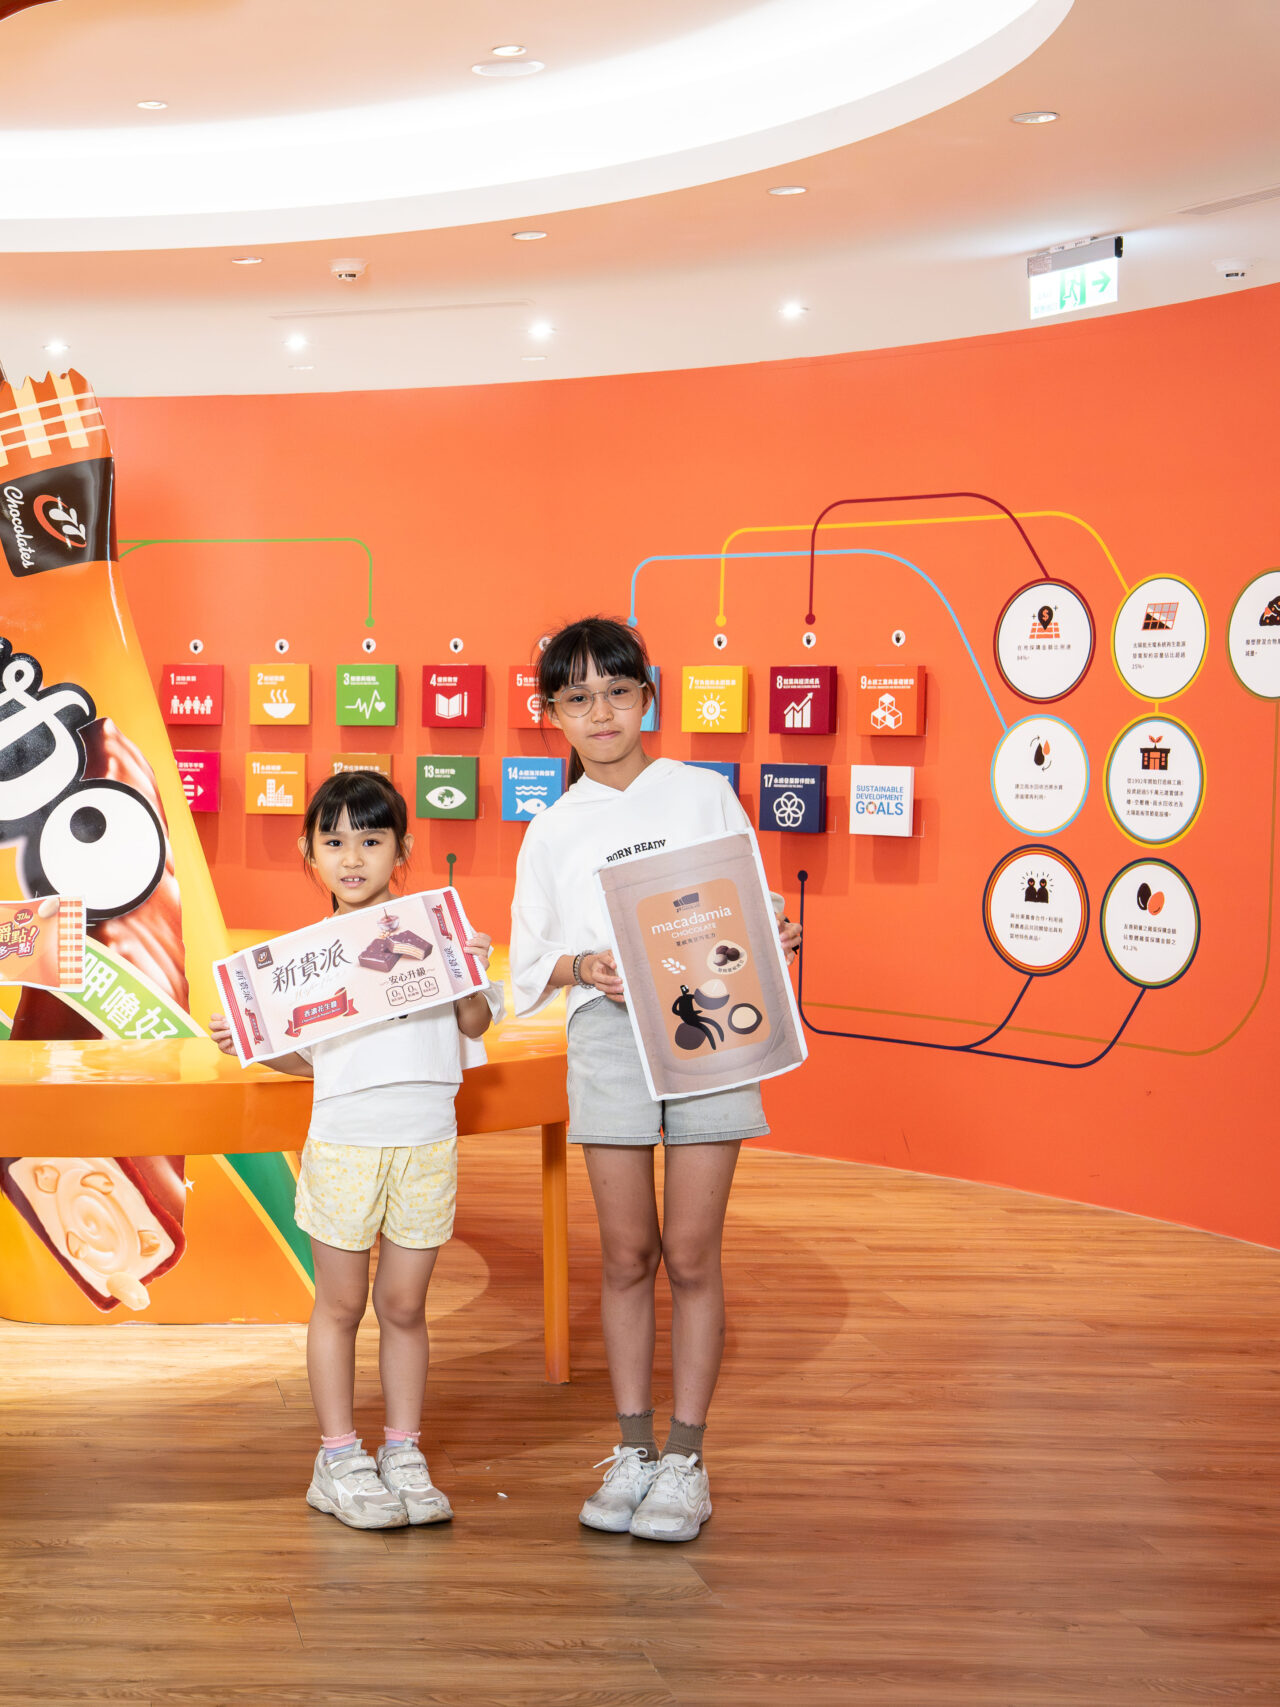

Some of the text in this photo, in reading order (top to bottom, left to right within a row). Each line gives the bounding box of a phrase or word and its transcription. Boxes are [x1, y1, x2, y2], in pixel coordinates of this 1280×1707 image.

[3, 485, 36, 569] Chocolates
[170, 672, 175, 685] 1
[257, 672, 263, 685] 2
[343, 672, 350, 685] 3
[429, 673, 437, 686] 4
[516, 674, 523, 686] 5
[688, 676, 695, 689] 7
[776, 675, 783, 689] 8
[860, 675, 868, 689] 9
[252, 762, 261, 775] 11
[333, 762, 343, 775] 12
[423, 765, 434, 778] 13
[508, 767, 518, 780] 14
[763, 774, 774, 788] 17
[855, 784, 904, 794] SUSTAINABLE
[855, 793, 904, 802] DEVELOPMENT
[855, 801, 904, 816] GOALS
[651, 905, 733, 935] macadamia
[671, 922, 717, 939] CHOCOLATE
[271, 939, 352, 995] 新貴派
[388, 967, 426, 986] 安心升級
